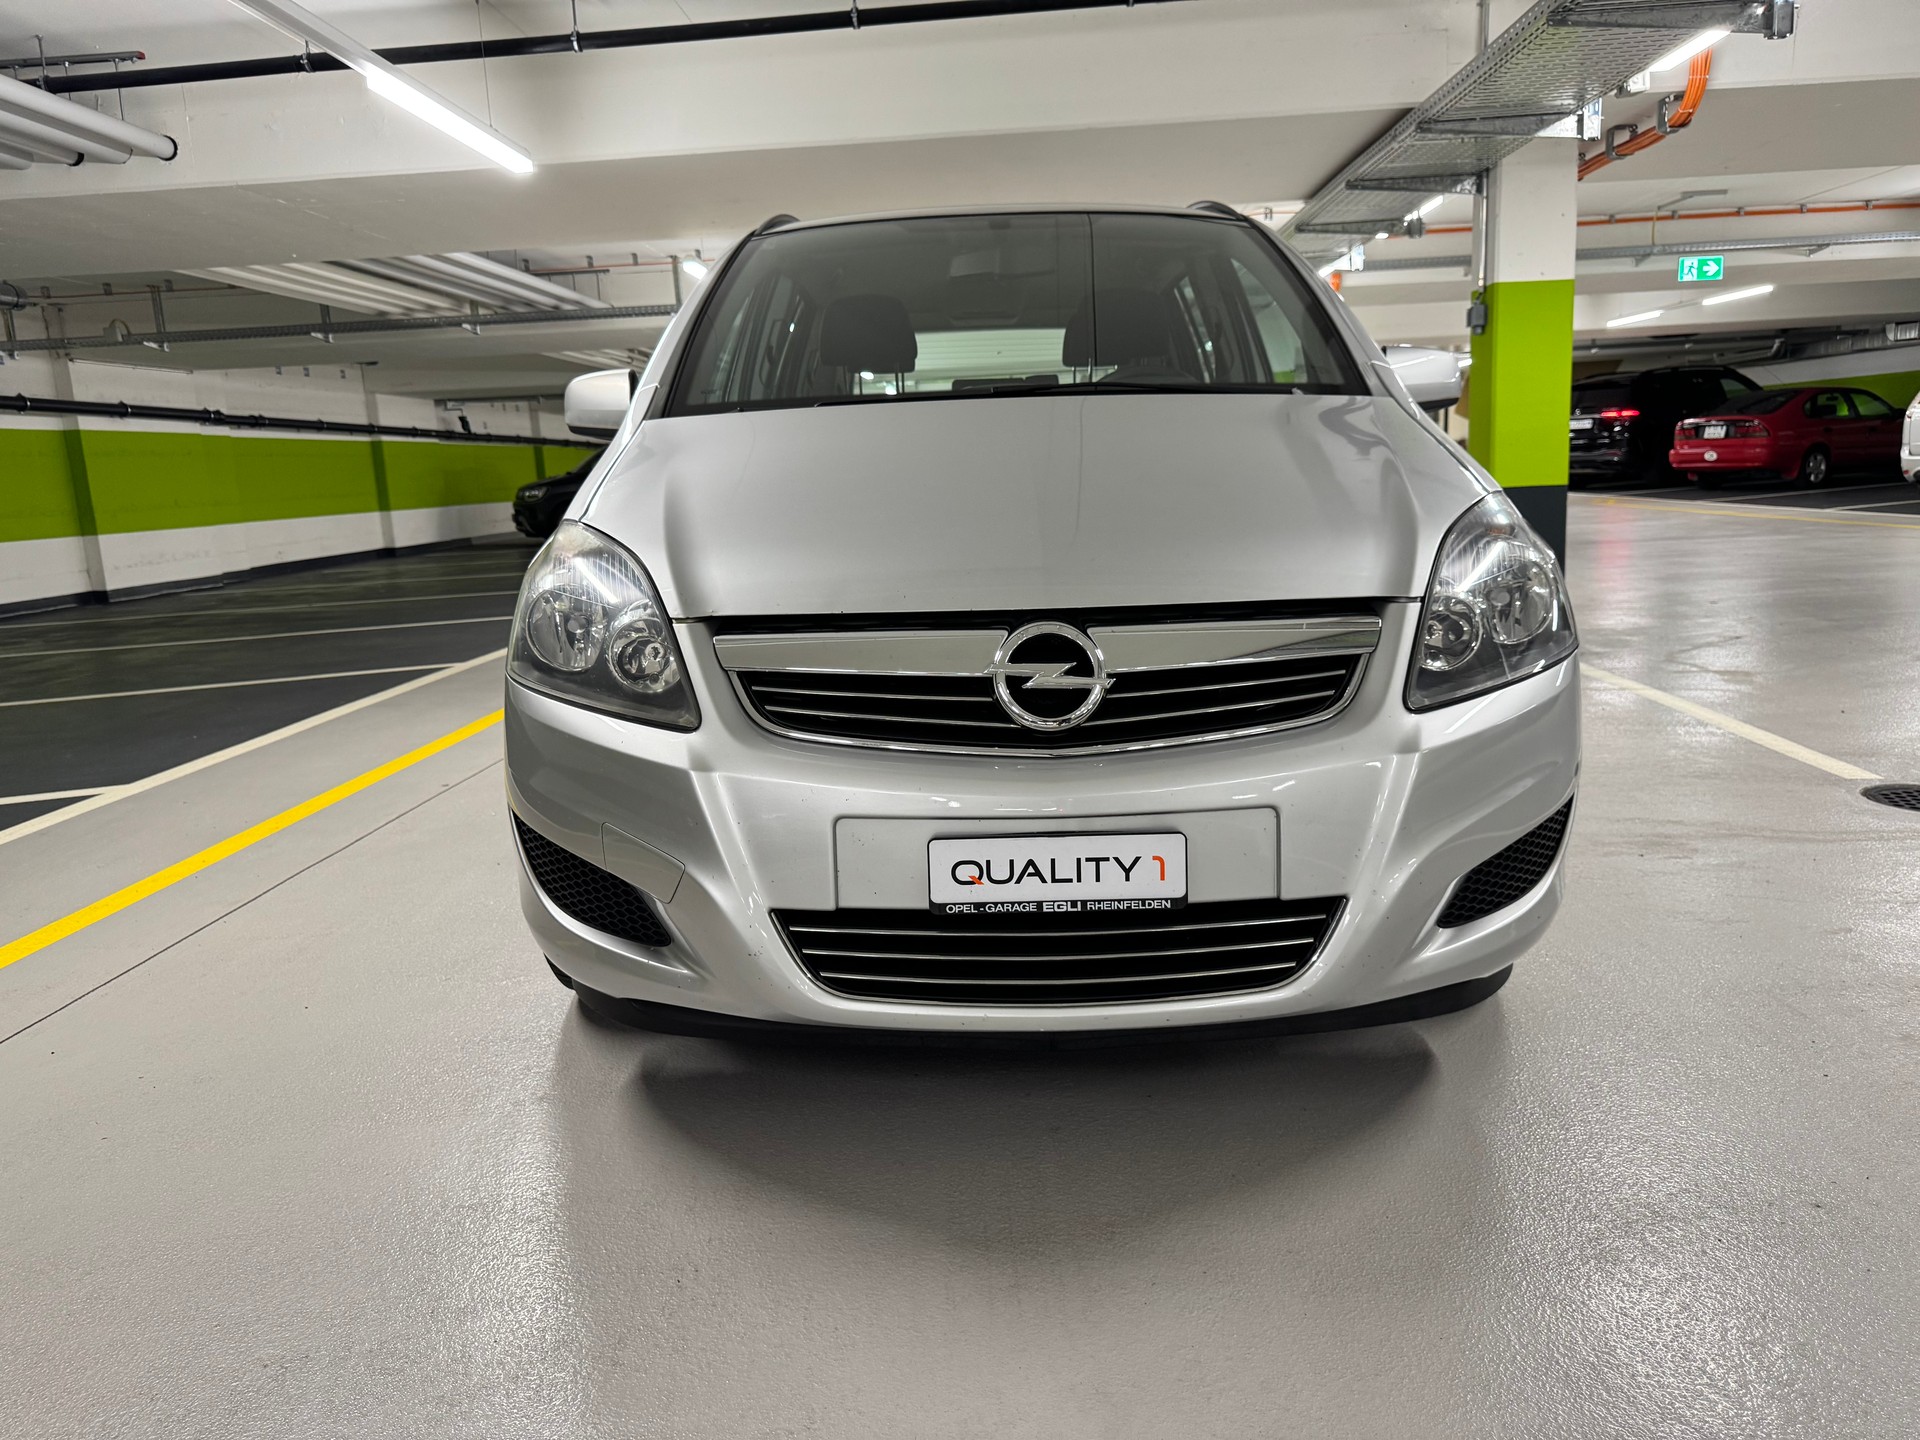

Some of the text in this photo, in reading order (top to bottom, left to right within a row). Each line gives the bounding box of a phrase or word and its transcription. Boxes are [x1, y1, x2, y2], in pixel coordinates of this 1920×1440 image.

[951, 855, 1166, 886] QUALITY 1
[1043, 901, 1081, 912] EGLI
[1087, 899, 1171, 911] RHEINFELDEN
